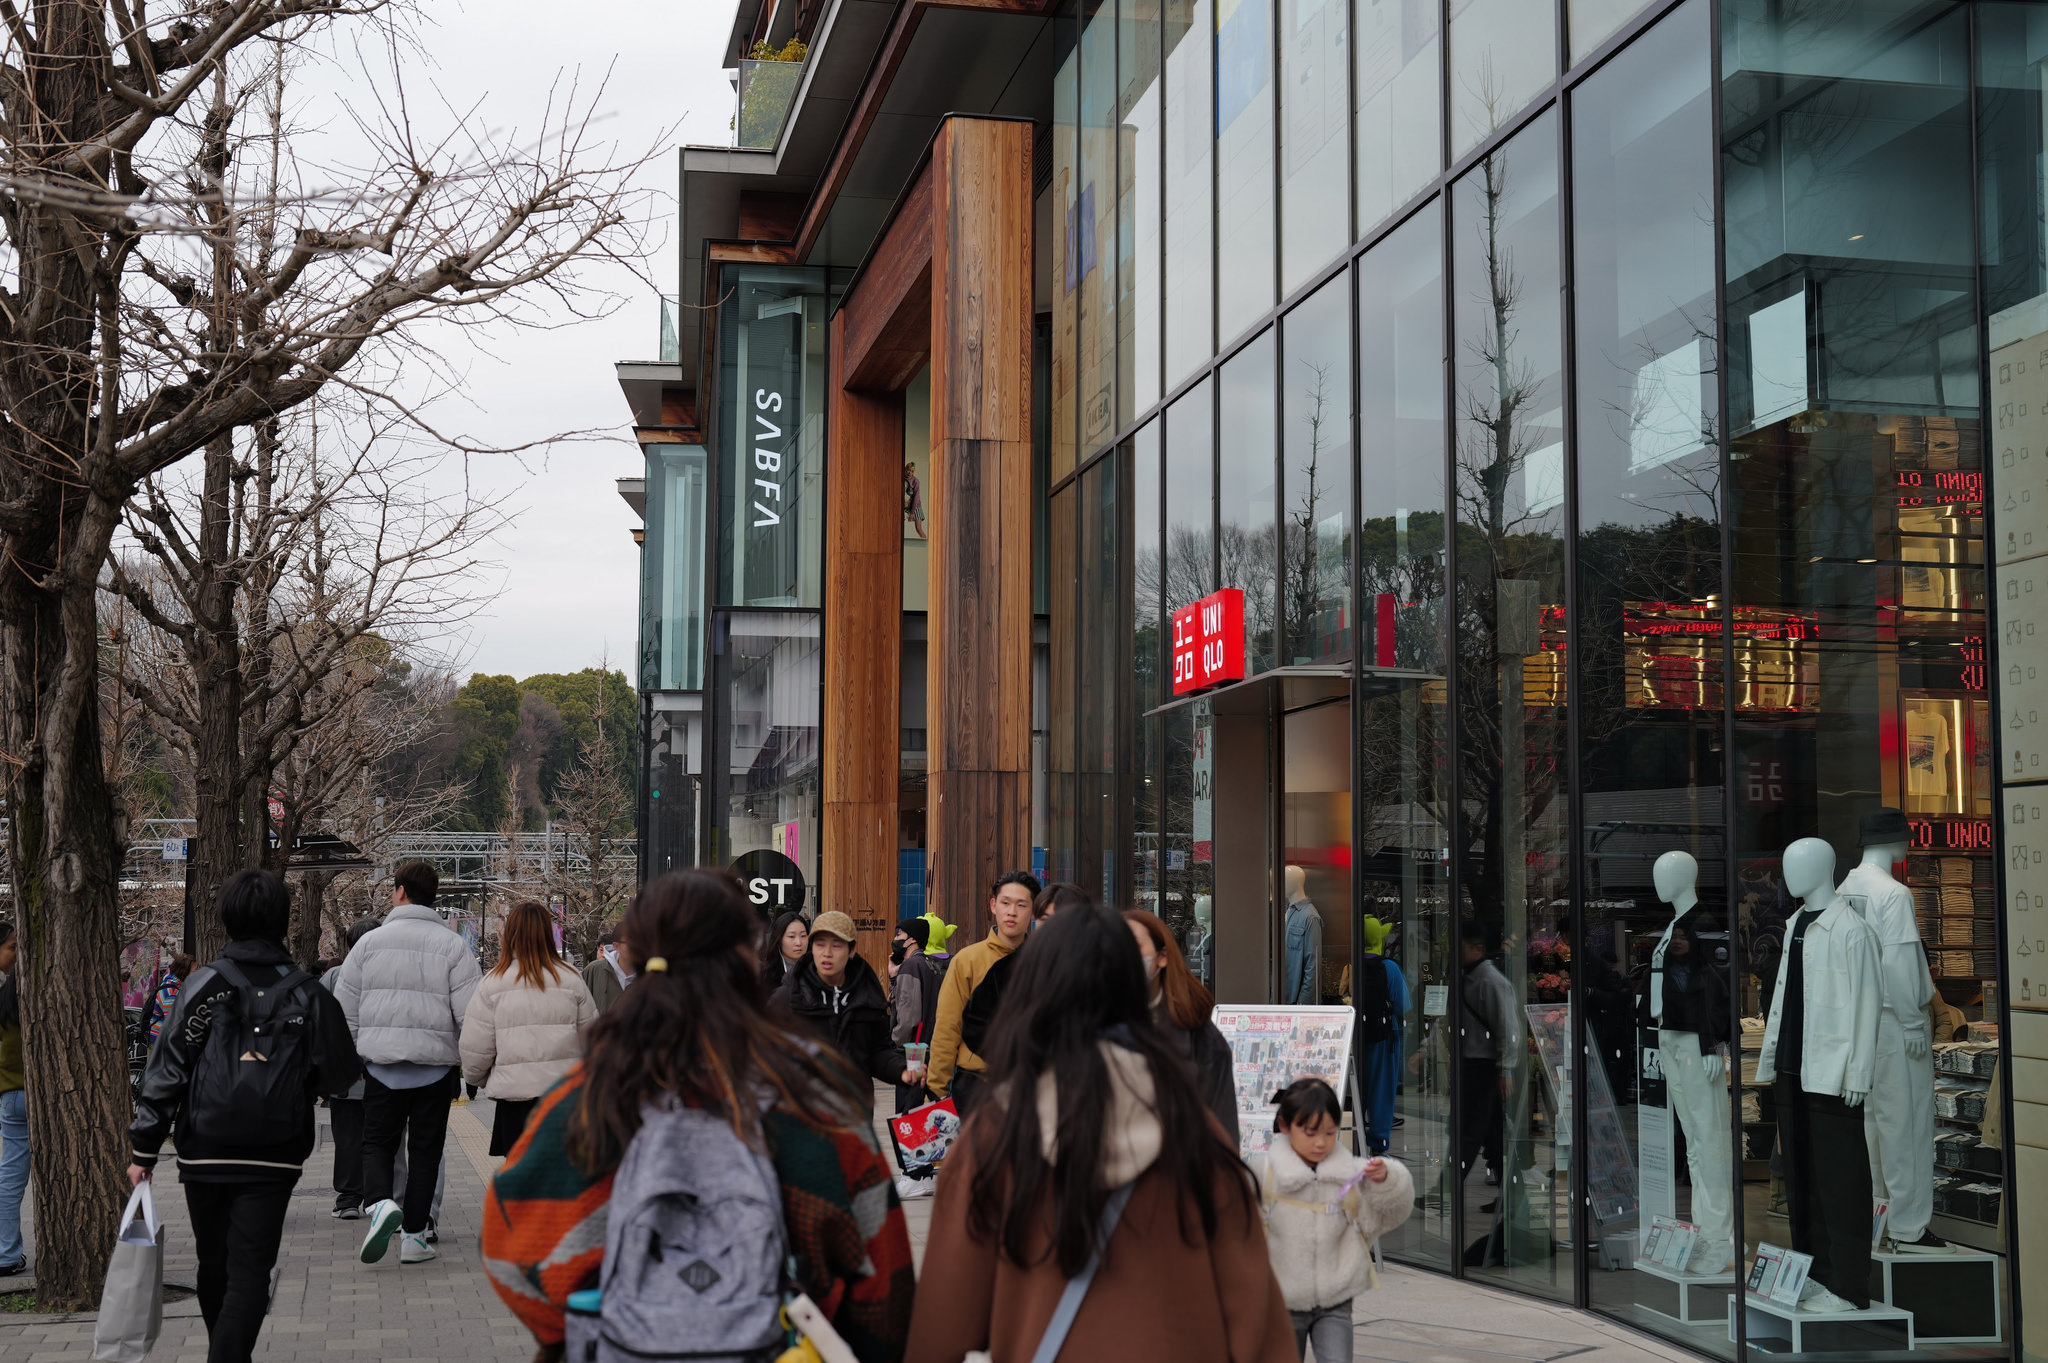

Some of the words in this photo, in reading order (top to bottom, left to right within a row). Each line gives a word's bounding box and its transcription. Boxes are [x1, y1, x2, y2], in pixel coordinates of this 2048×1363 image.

[1175, 615, 1193, 649] ユニ
[1203, 602, 1221, 637] UNI
[1175, 651, 1193, 684] クロ
[1203, 639, 1224, 678] QLO
[1908, 822, 1933, 847] TO
[1946, 822, 1991, 848] UNIQ
